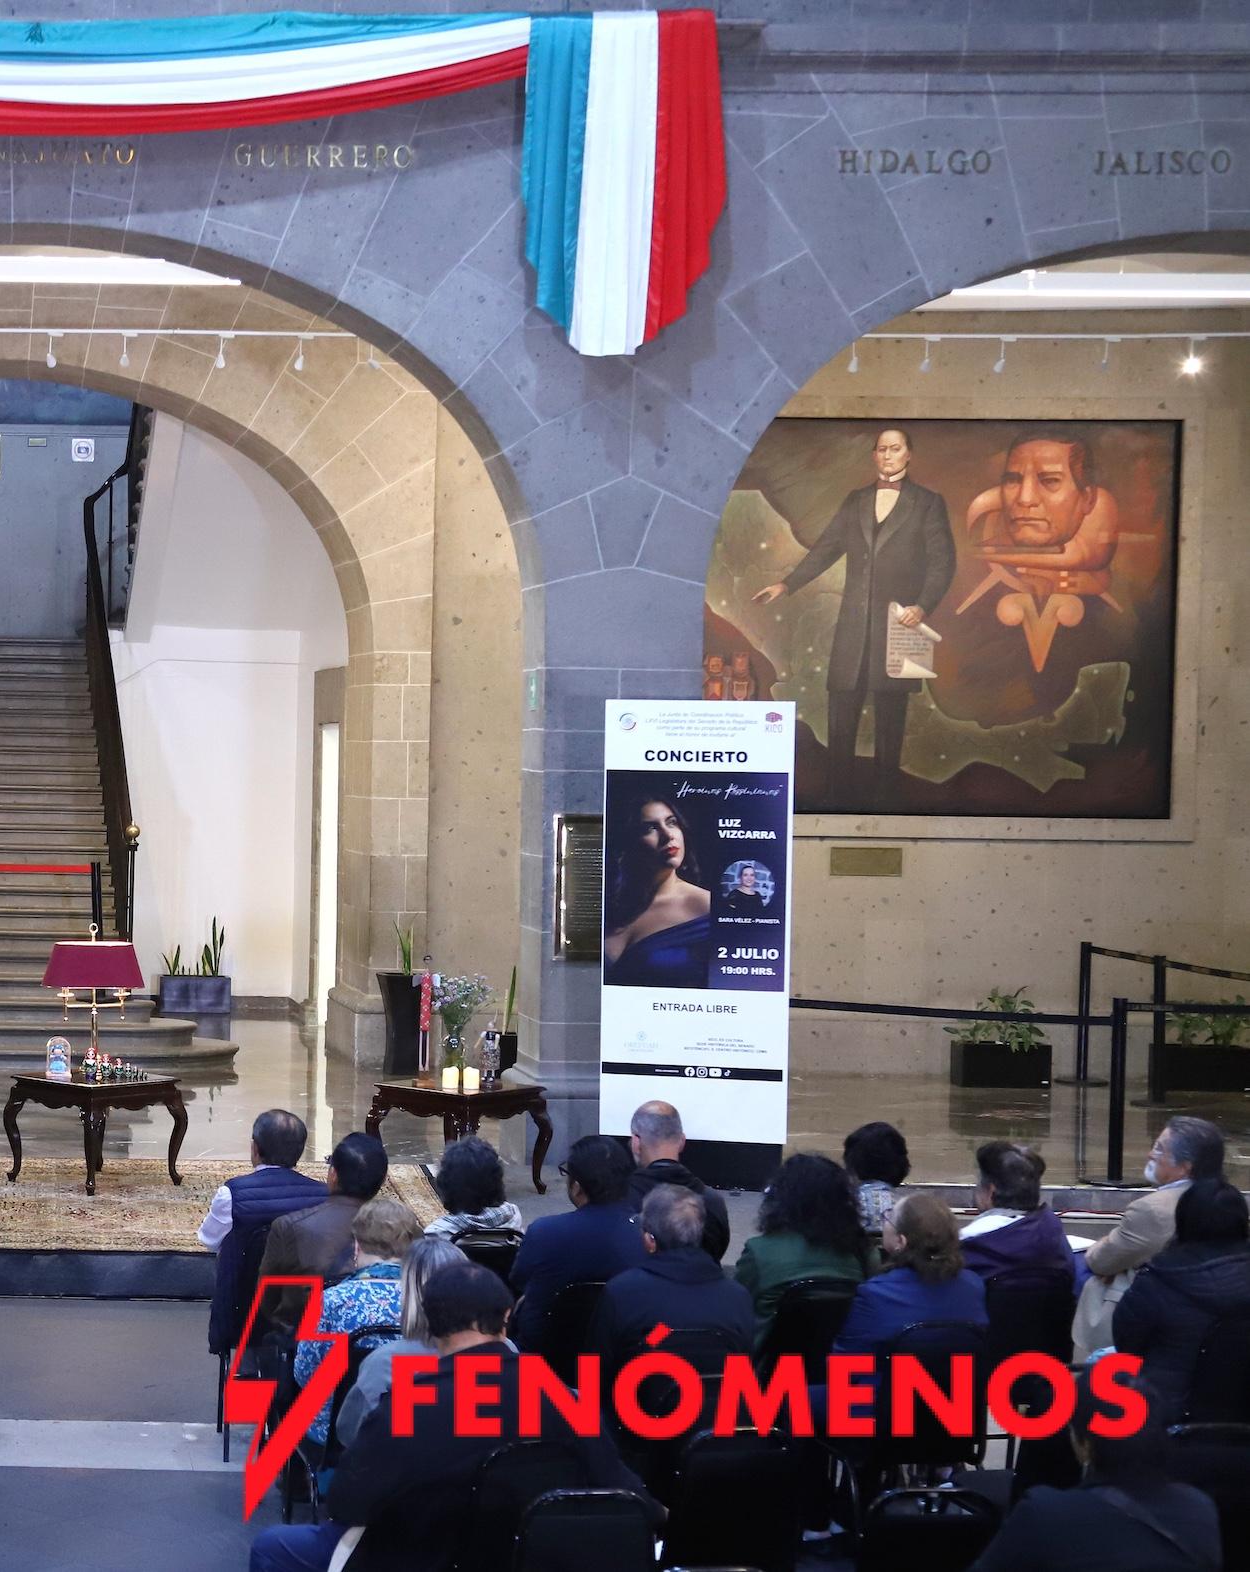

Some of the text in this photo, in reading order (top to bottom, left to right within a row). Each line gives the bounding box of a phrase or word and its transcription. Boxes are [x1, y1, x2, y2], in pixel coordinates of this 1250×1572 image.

[234, 143, 415, 169] GUERRERO
[838, 149, 992, 175] HIDALGO
[1093, 150, 1232, 176] JALISCO
[644, 750, 748, 764] CONCIERTO
[718, 818, 741, 828] LUZ
[717, 829, 777, 840] VIZCARRA
[717, 946, 780, 960] 2 JULIO
[720, 965, 776, 976] 19:00 HRS.
[652, 1002, 738, 1014] ENTRADA LIBRE
